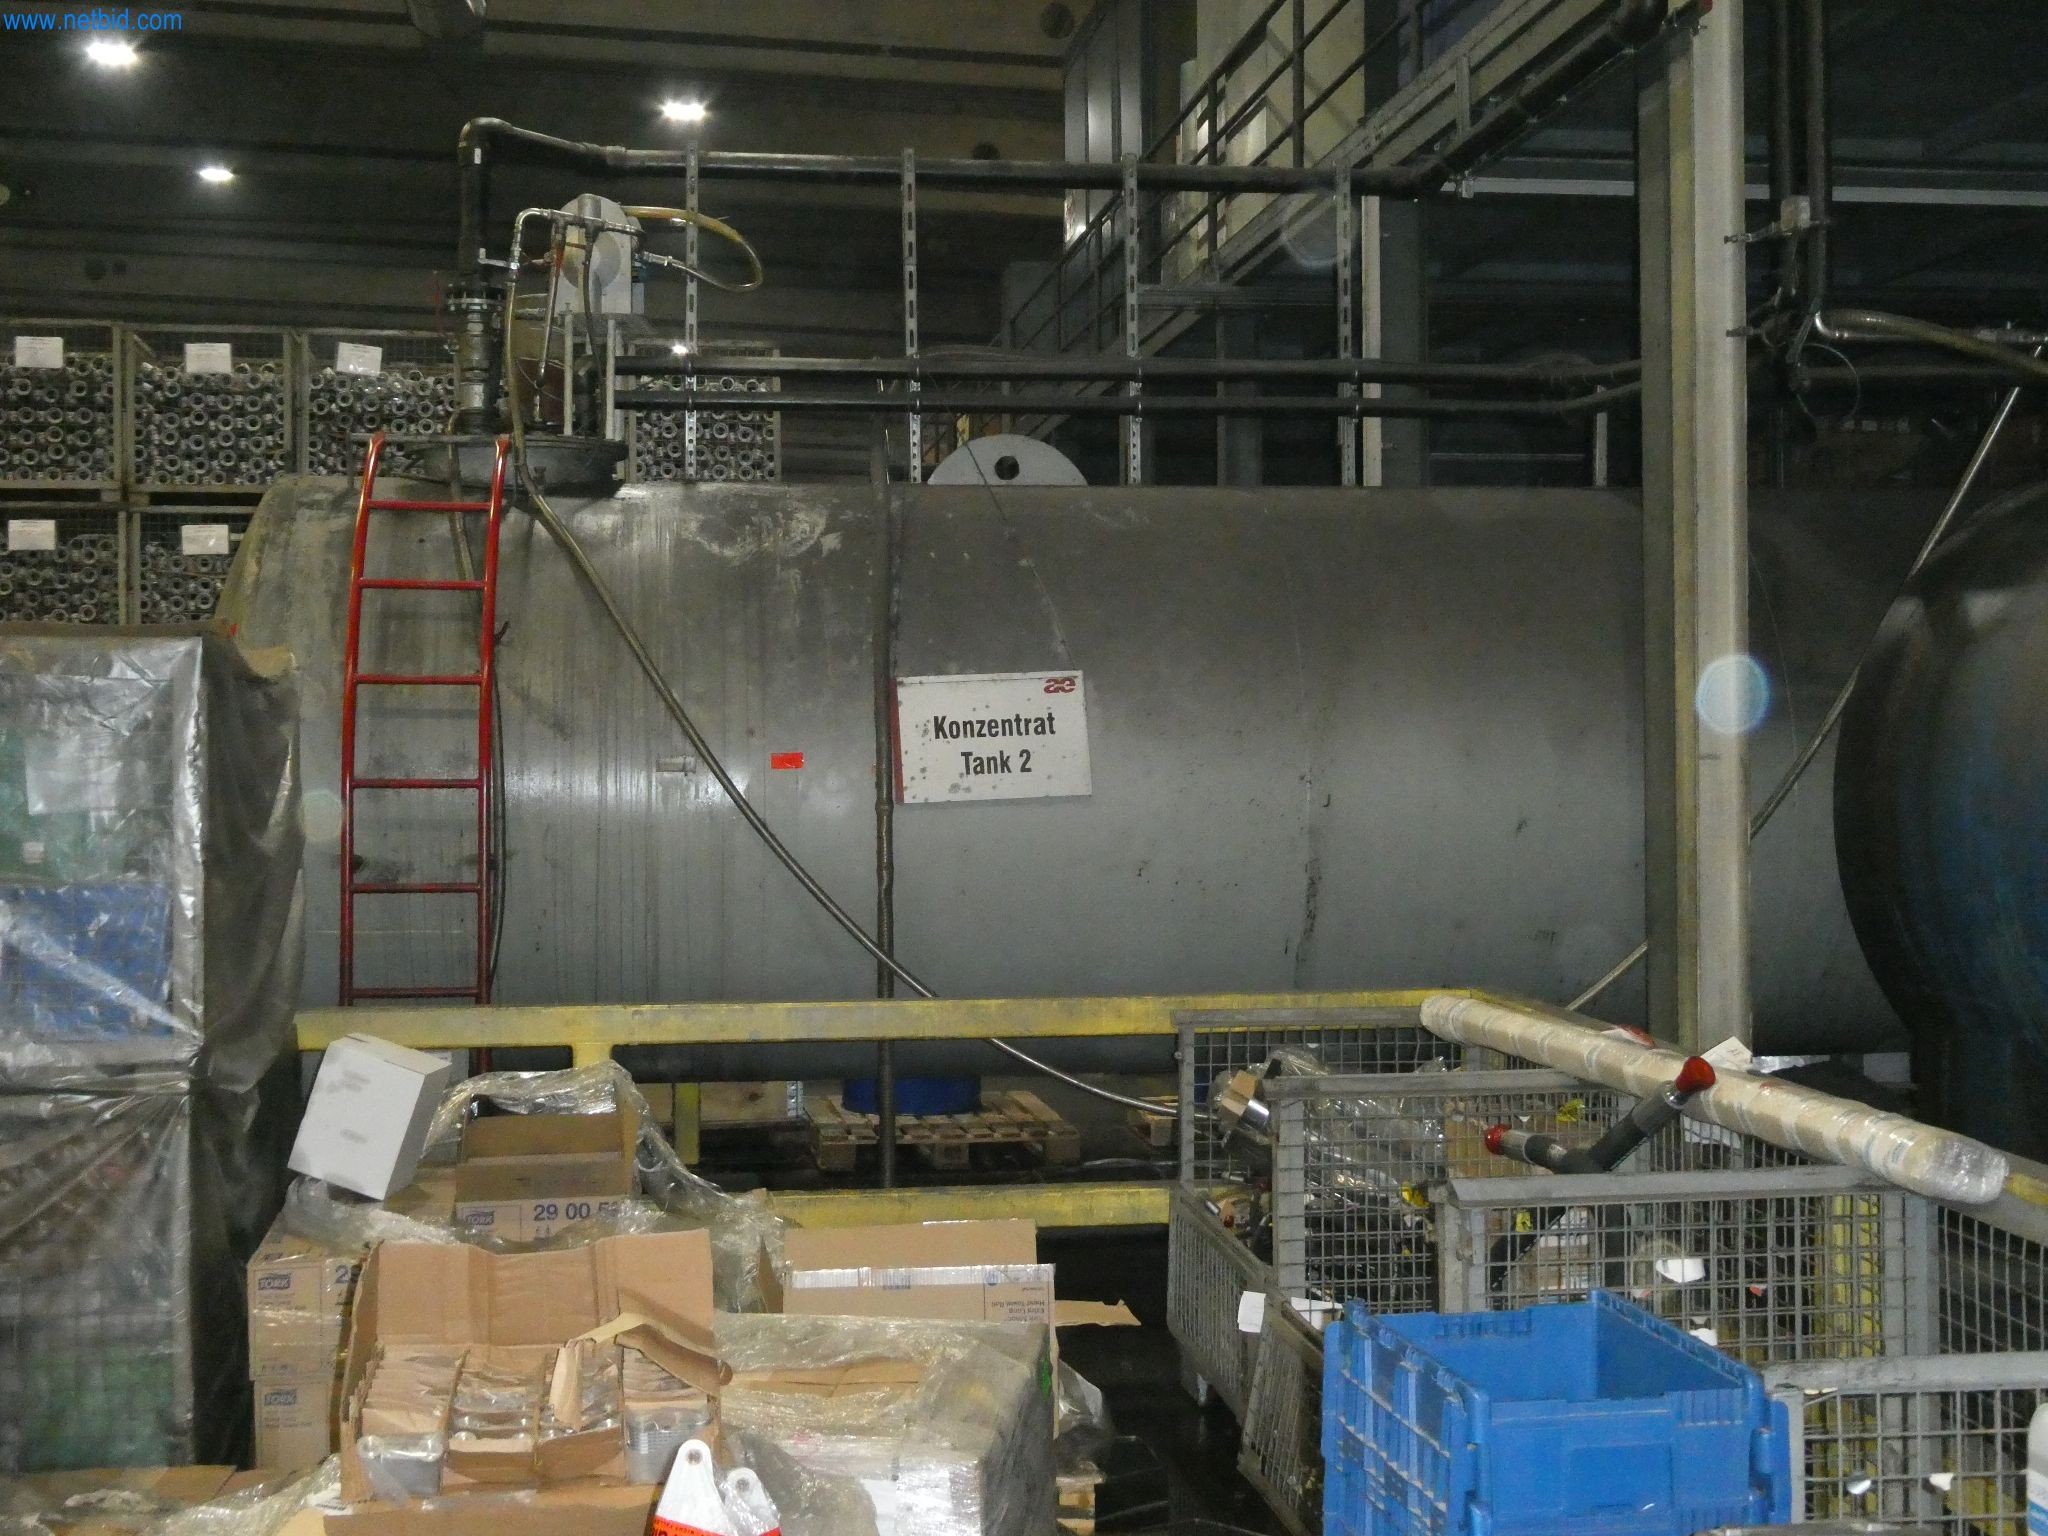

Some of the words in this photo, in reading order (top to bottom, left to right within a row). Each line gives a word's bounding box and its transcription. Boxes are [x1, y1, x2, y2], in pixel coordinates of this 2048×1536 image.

[933, 712, 1056, 740] Konzentrat
[961, 750, 1012, 776] Tank
[1019, 749, 1032, 773] 2
[465, 1211, 495, 1226] TORK
[533, 1203, 559, 1221] 29
[565, 1202, 591, 1220] 00
[258, 1273, 292, 1291] TORK
[264, 1389, 297, 1406] TORK
